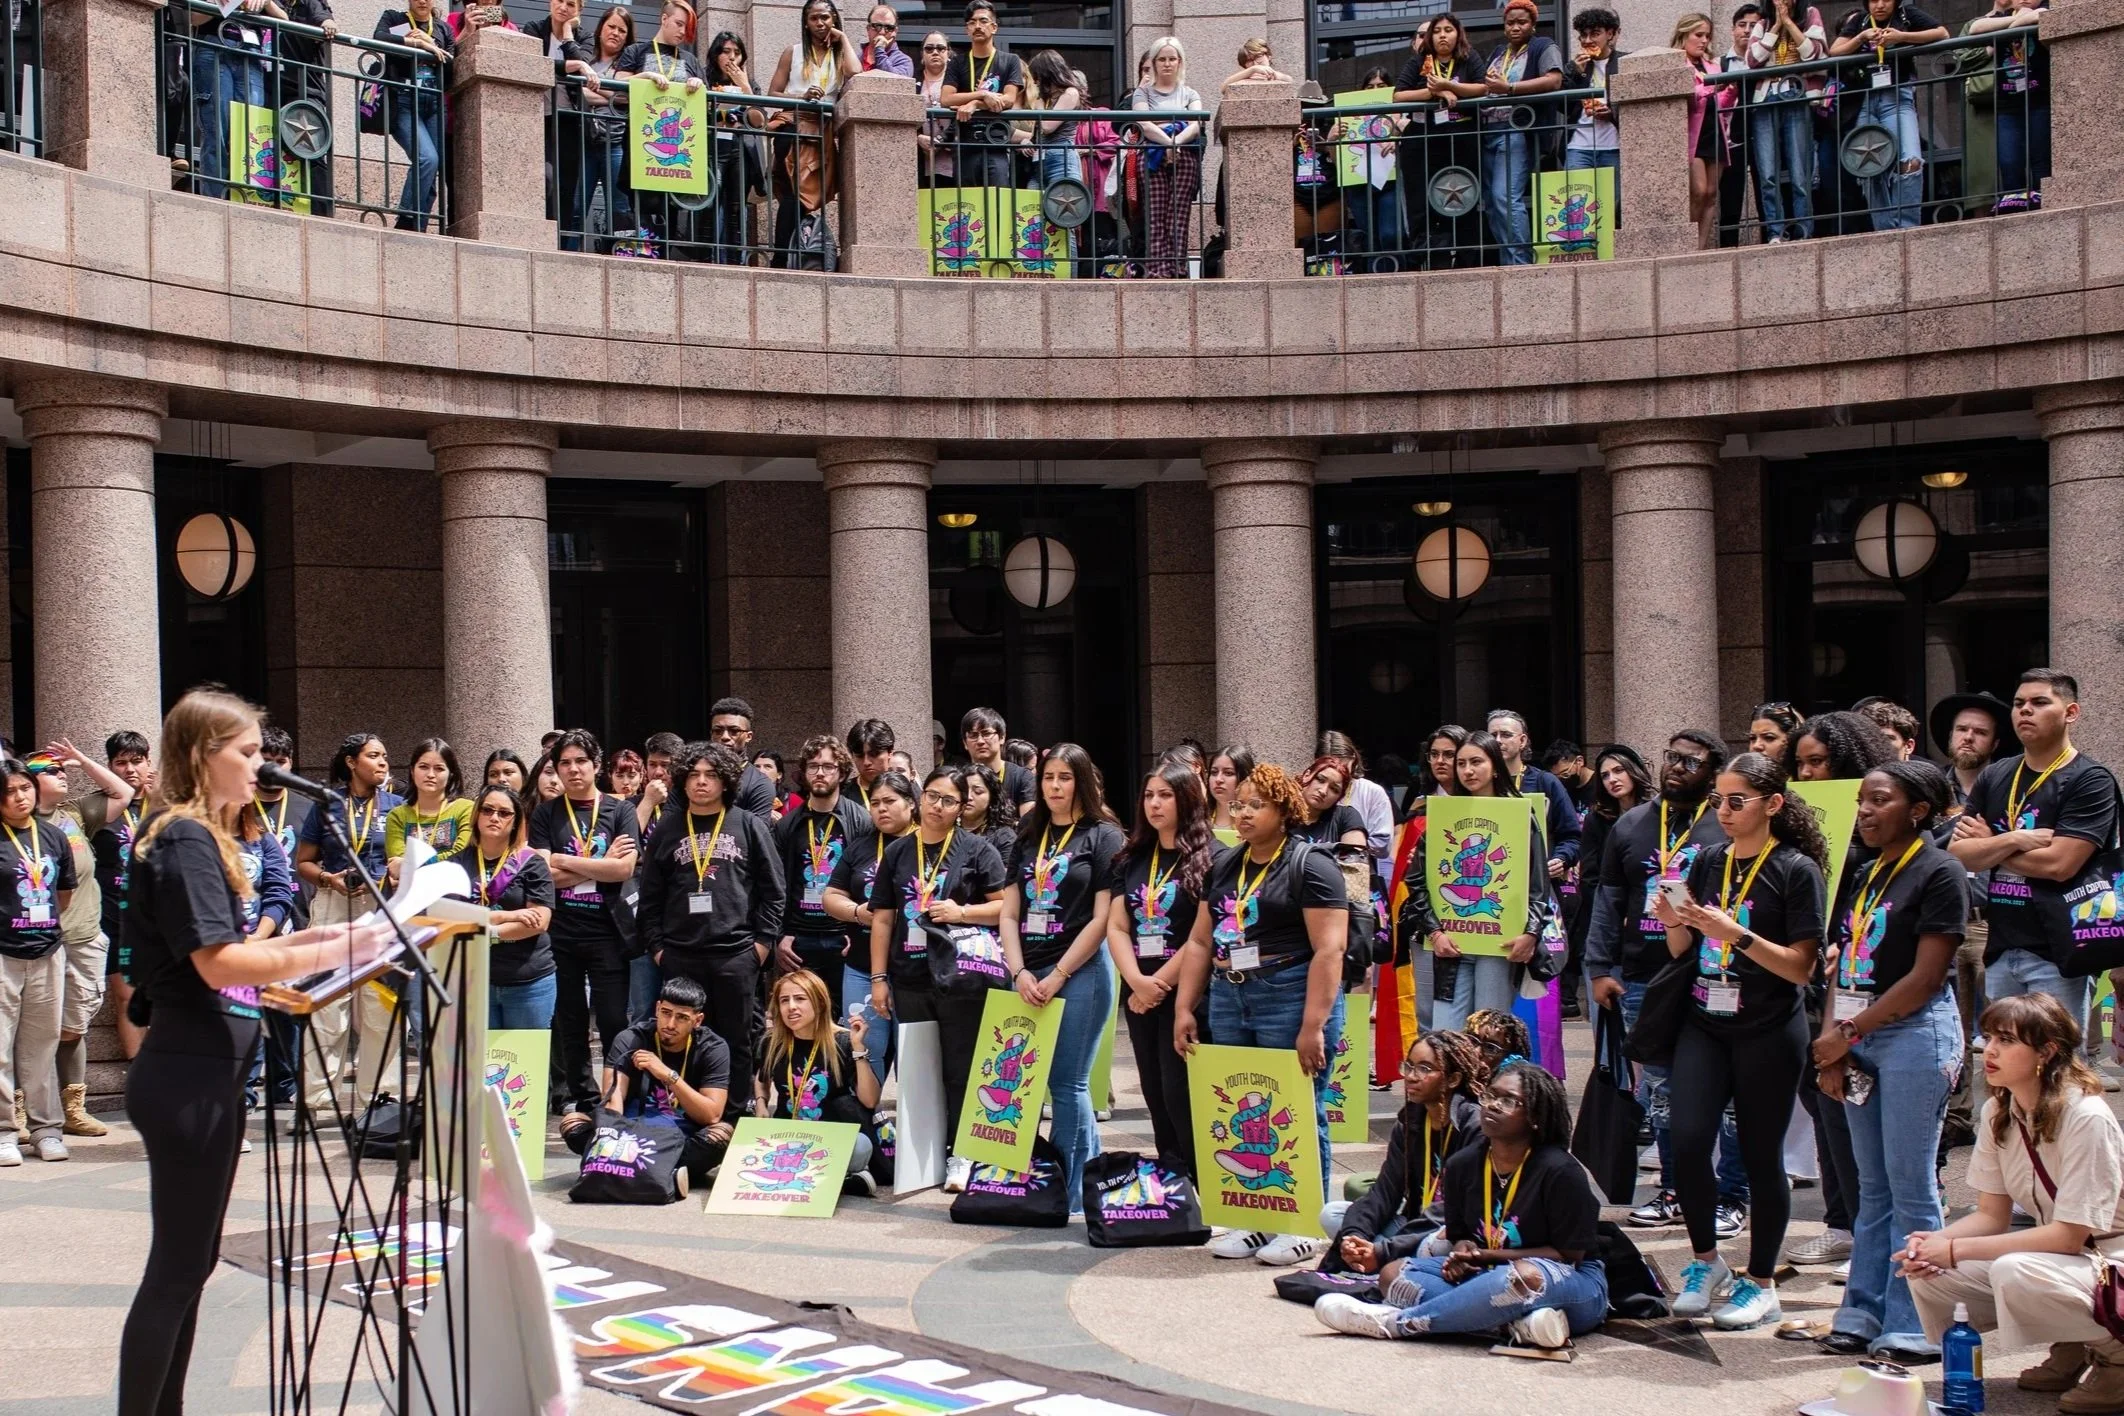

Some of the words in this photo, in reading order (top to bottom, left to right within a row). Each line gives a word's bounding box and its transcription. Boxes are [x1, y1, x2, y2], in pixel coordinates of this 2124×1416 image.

[645, 167, 693, 180] TAKEOVER
[1454, 818, 1473, 833] YOUTH
[1474, 817, 1500, 835] CAPITOL
[2062, 887, 2086, 904] YOUTH
[2086, 880, 2112, 895] CAPITOL
[1440, 918, 1503, 936] TAKEOVER
[956, 960, 1006, 979] TAKEOVER
[491, 1048, 519, 1064] CAPITOL
[1224, 1073, 1249, 1090] YOUTH
[1250, 1072, 1281, 1095] CAPITOL
[770, 1132, 795, 1140] YOUTH
[795, 1132, 824, 1144] CAPITOL
[970, 1122, 1017, 1147] TAKEOVER
[733, 1191, 811, 1203] TAKEOVER
[969, 1183, 1027, 1197] TAKEOVER
[1221, 1190, 1300, 1213] TAKEOVER
[1102, 1209, 1170, 1219] TAKEOVER
